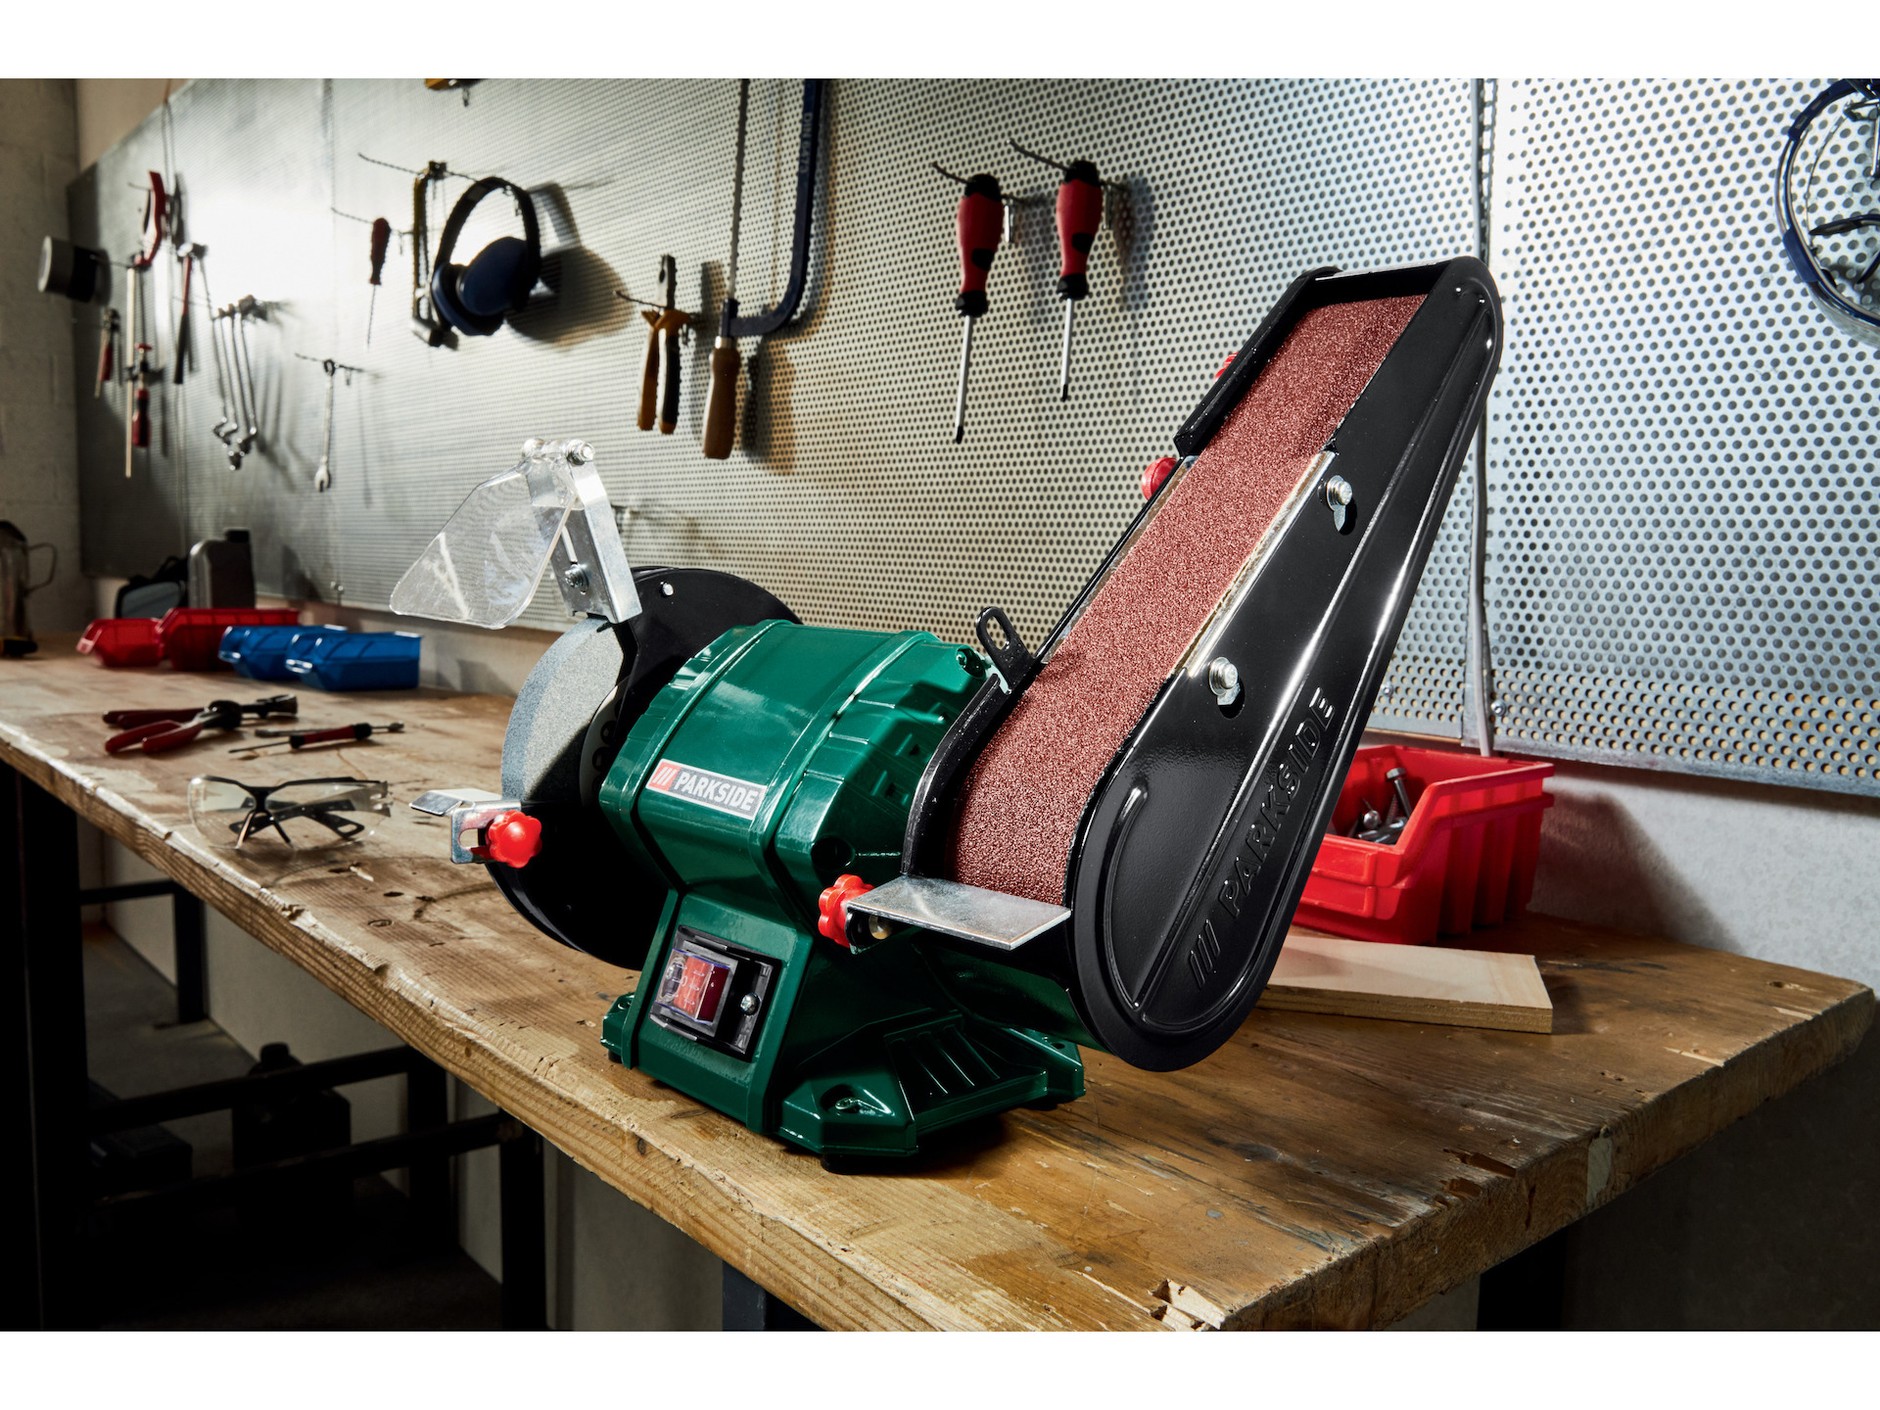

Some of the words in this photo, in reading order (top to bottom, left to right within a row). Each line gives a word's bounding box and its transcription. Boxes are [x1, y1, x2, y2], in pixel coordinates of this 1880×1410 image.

[803, 113, 812, 138] DIN
[674, 772, 758, 810] PARKSIDE
[1219, 687, 1336, 917] PARKSIDE
